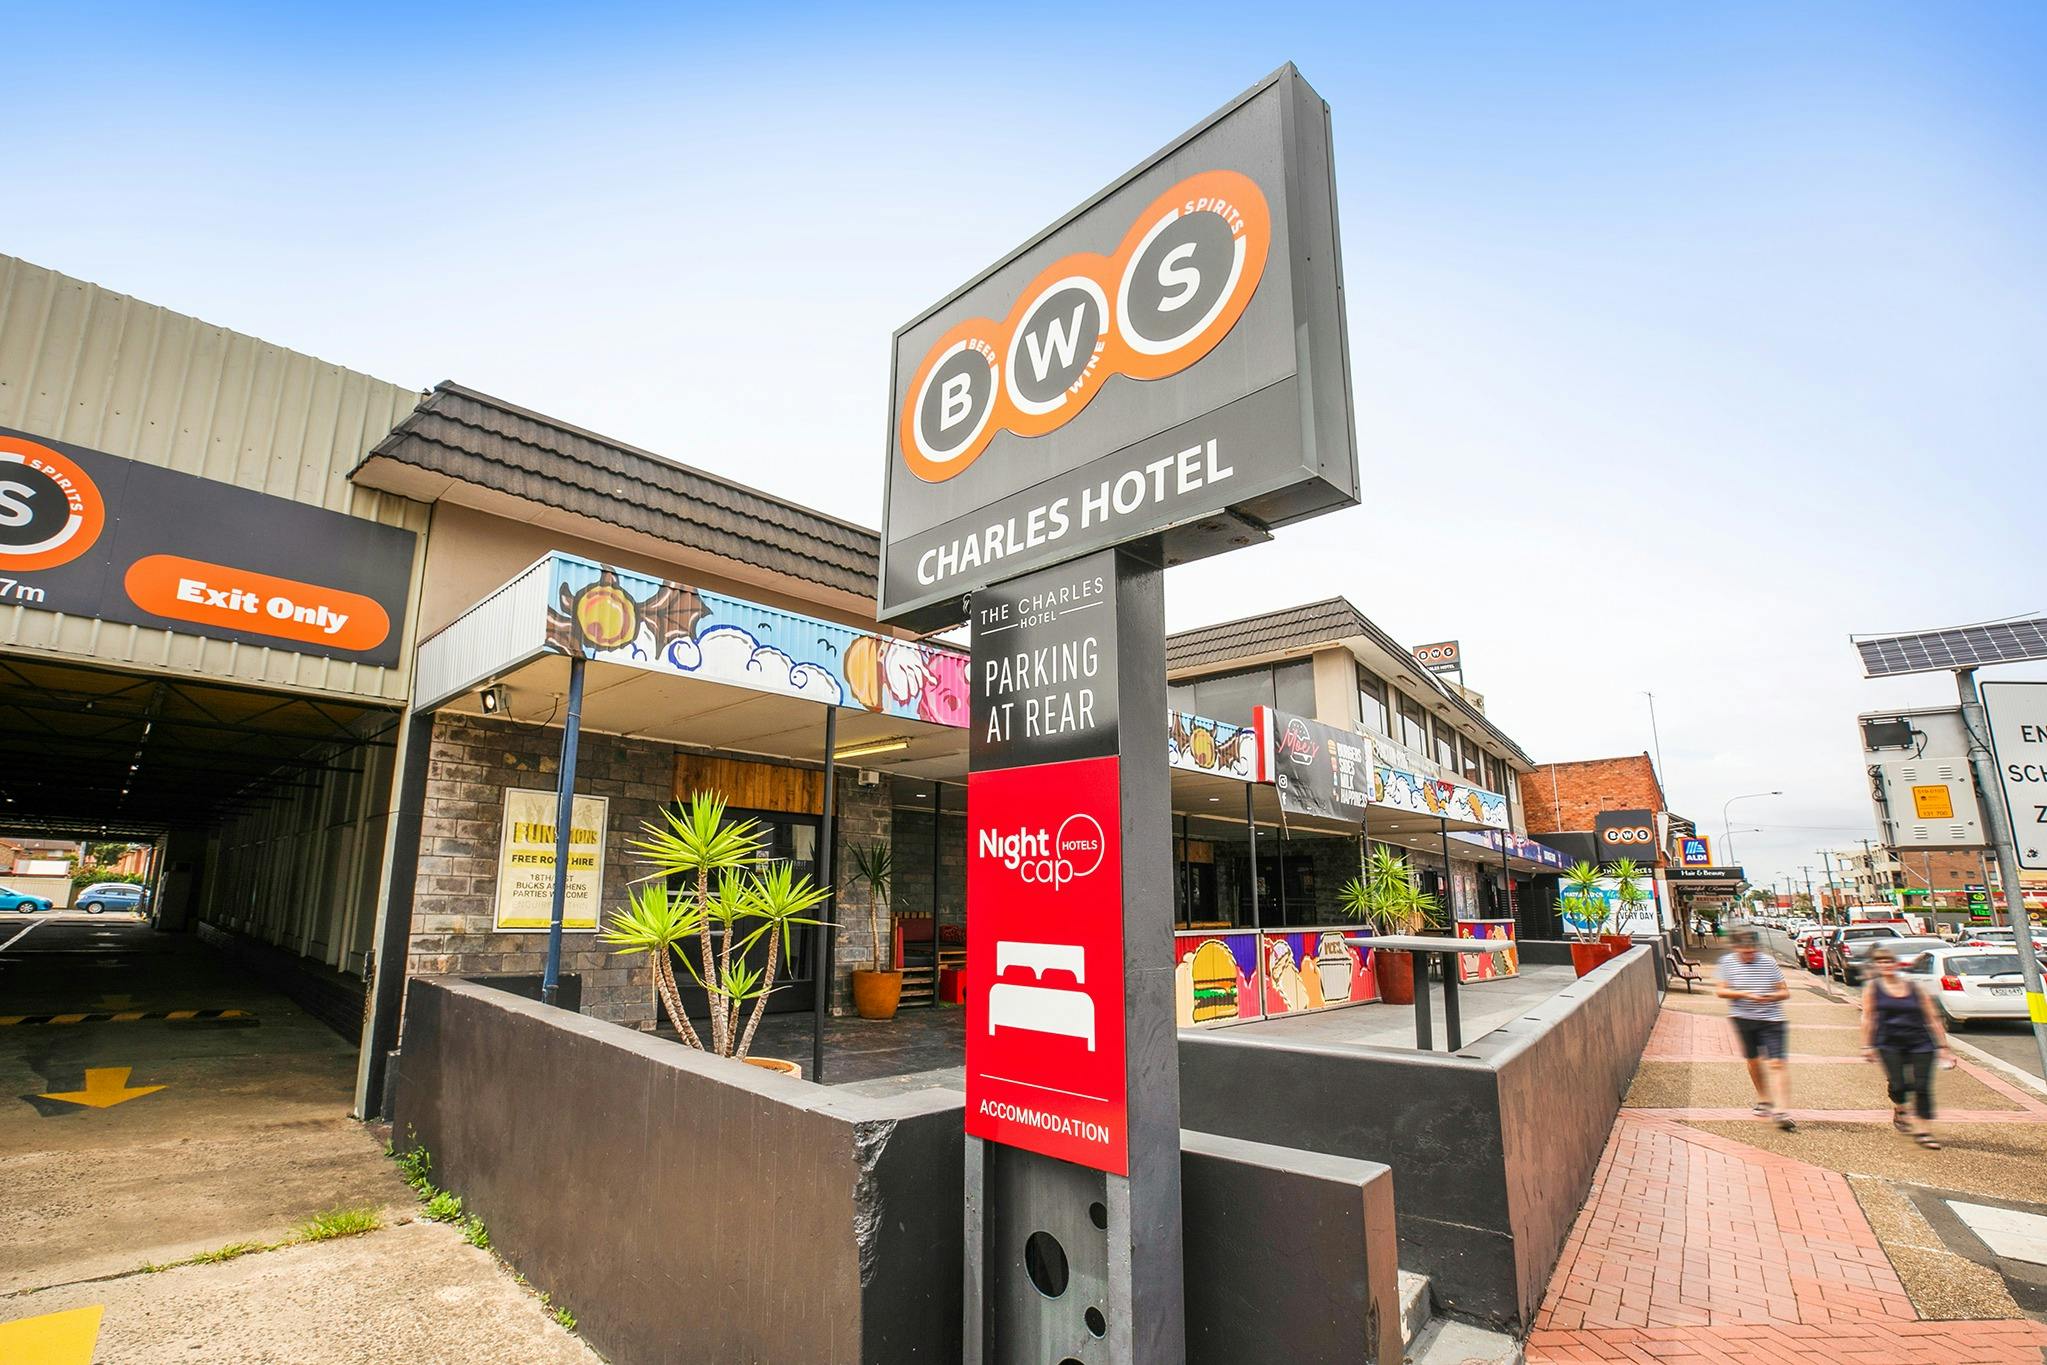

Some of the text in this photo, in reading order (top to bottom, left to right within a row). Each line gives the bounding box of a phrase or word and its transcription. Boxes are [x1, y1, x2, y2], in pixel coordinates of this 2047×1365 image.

[1183, 198, 1245, 235] SPIRITS
[966, 338, 996, 367] BEER
[1068, 340, 1105, 397] WINE
[29, 459, 83, 512] SPIRITS
[916, 437, 1234, 587] CHARLES HOTEL
[176, 578, 349, 634] Exit Only
[981, 577, 1104, 625] THE CHARLES
[1020, 611, 1057, 629] HOTEL
[985, 636, 1098, 697] PARKING
[986, 688, 1096, 744] AT REAR
[1278, 728, 1320, 759] Moe's
[513, 822, 598, 844] FUNIONS
[979, 826, 1050, 871] Night
[1061, 838, 1098, 852] HOTELS
[511, 854, 537, 864] FREE
[572, 857, 594, 866] HIRE
[1020, 856, 1074, 892] cap
[1681, 869, 1696, 877] Hair
[1703, 869, 1725, 877] Beauty
[512, 890, 547, 898] PARTIES
[516, 882, 545, 890] BUCKS
[1634, 903, 1648, 912] DAY
[1639, 911, 1654, 920] DAY
[979, 1098, 1110, 1145] ACCOMMODATION
